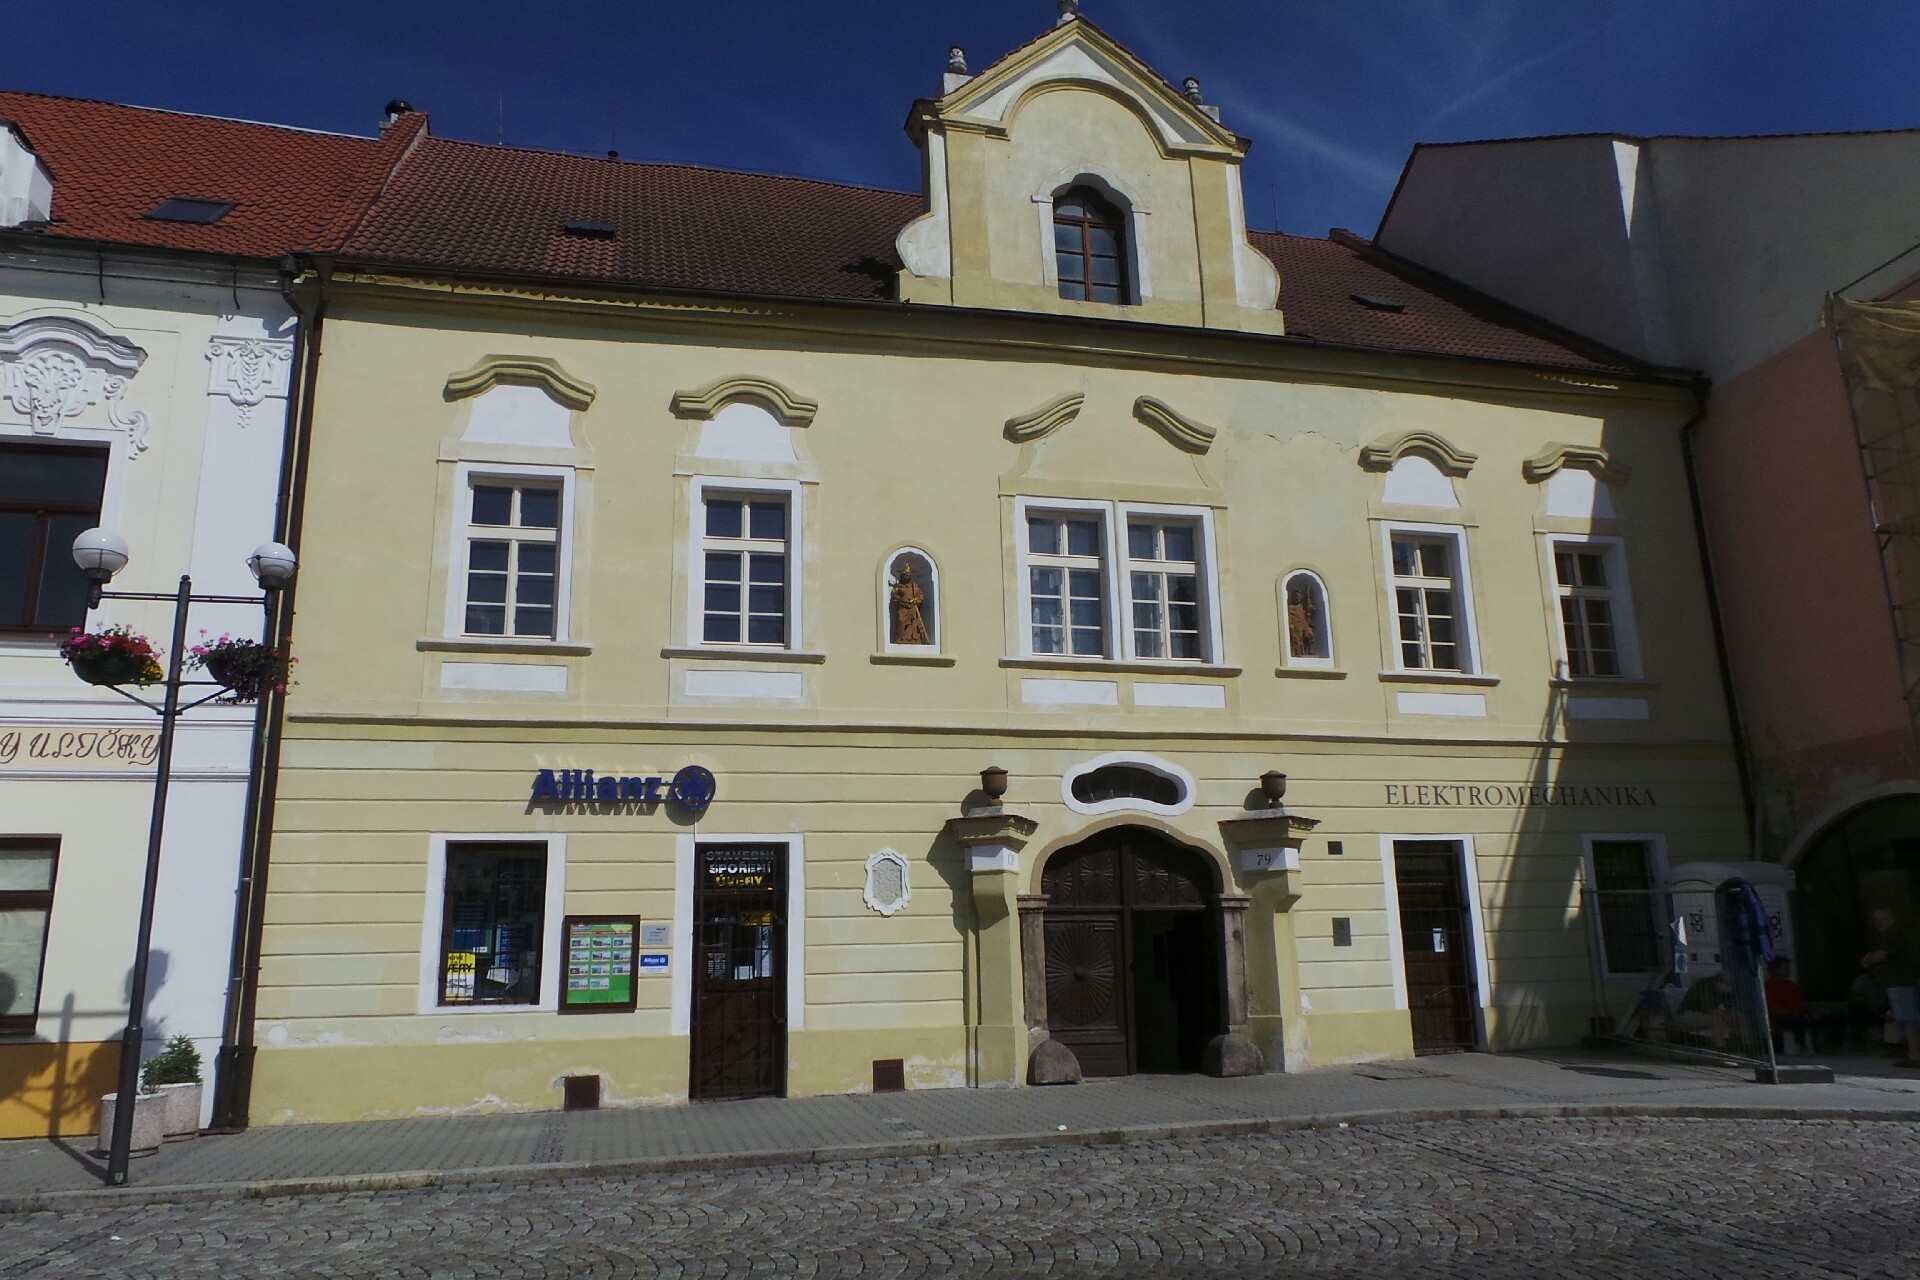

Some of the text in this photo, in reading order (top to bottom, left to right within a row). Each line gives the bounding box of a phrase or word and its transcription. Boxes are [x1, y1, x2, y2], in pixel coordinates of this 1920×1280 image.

[532, 768, 662, 800] Allianz
[1384, 784, 1658, 807] ELEKTROMECHANIKA
[1256, 854, 1272, 866] 79
